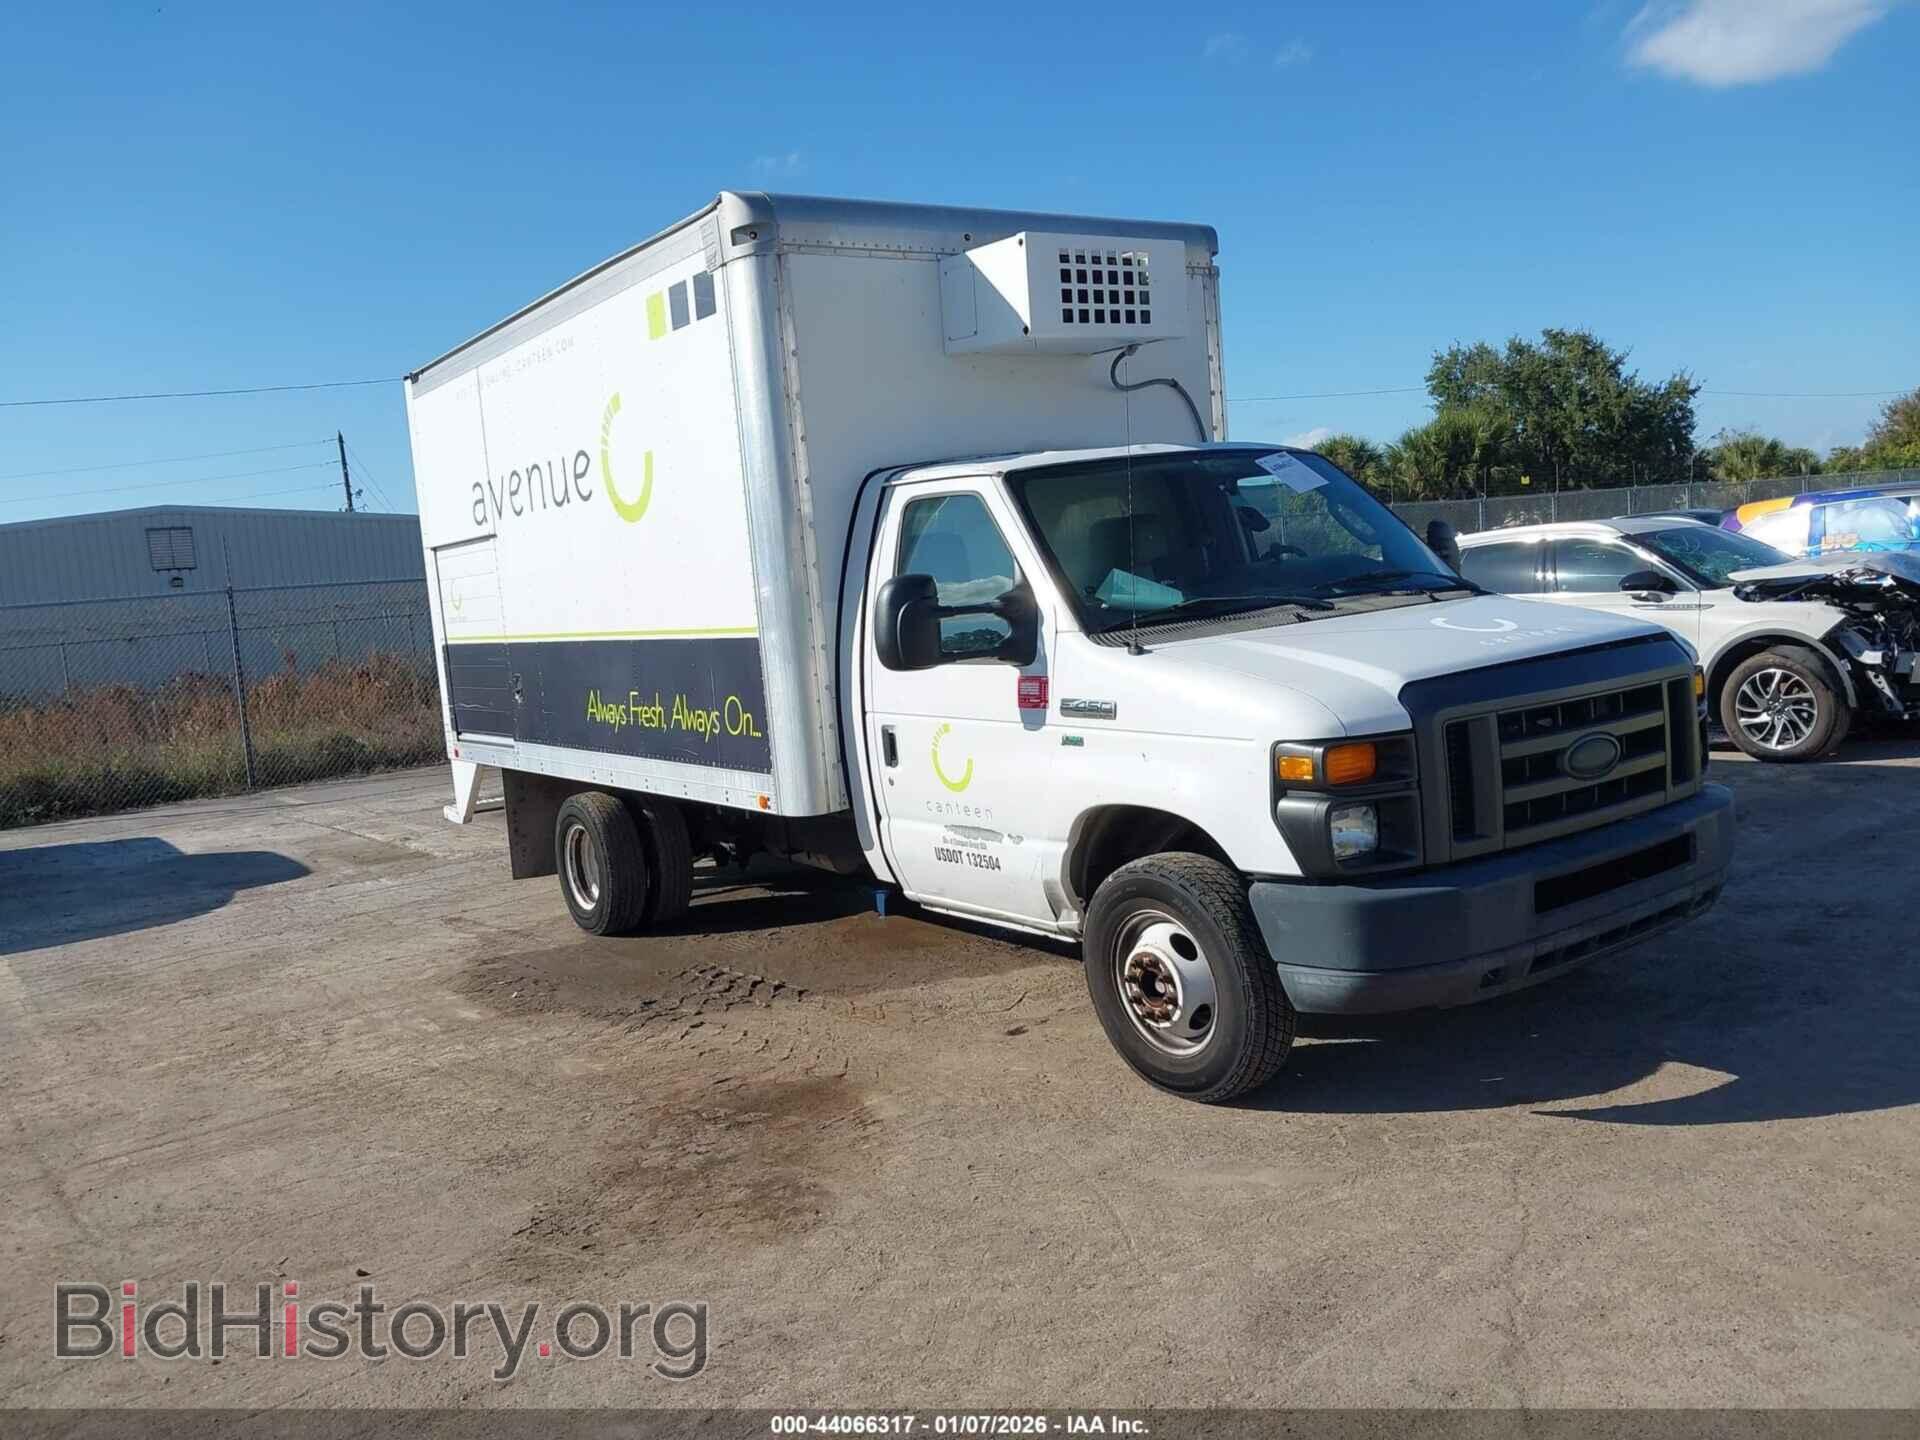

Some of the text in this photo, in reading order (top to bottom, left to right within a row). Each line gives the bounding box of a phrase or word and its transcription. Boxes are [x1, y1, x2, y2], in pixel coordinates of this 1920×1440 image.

[472, 449, 593, 527] avenue
[587, 689, 763, 743] Always Fresh, Always On...
[926, 800, 993, 822] canteen
[934, 846, 1002, 872] USDOT 132504
